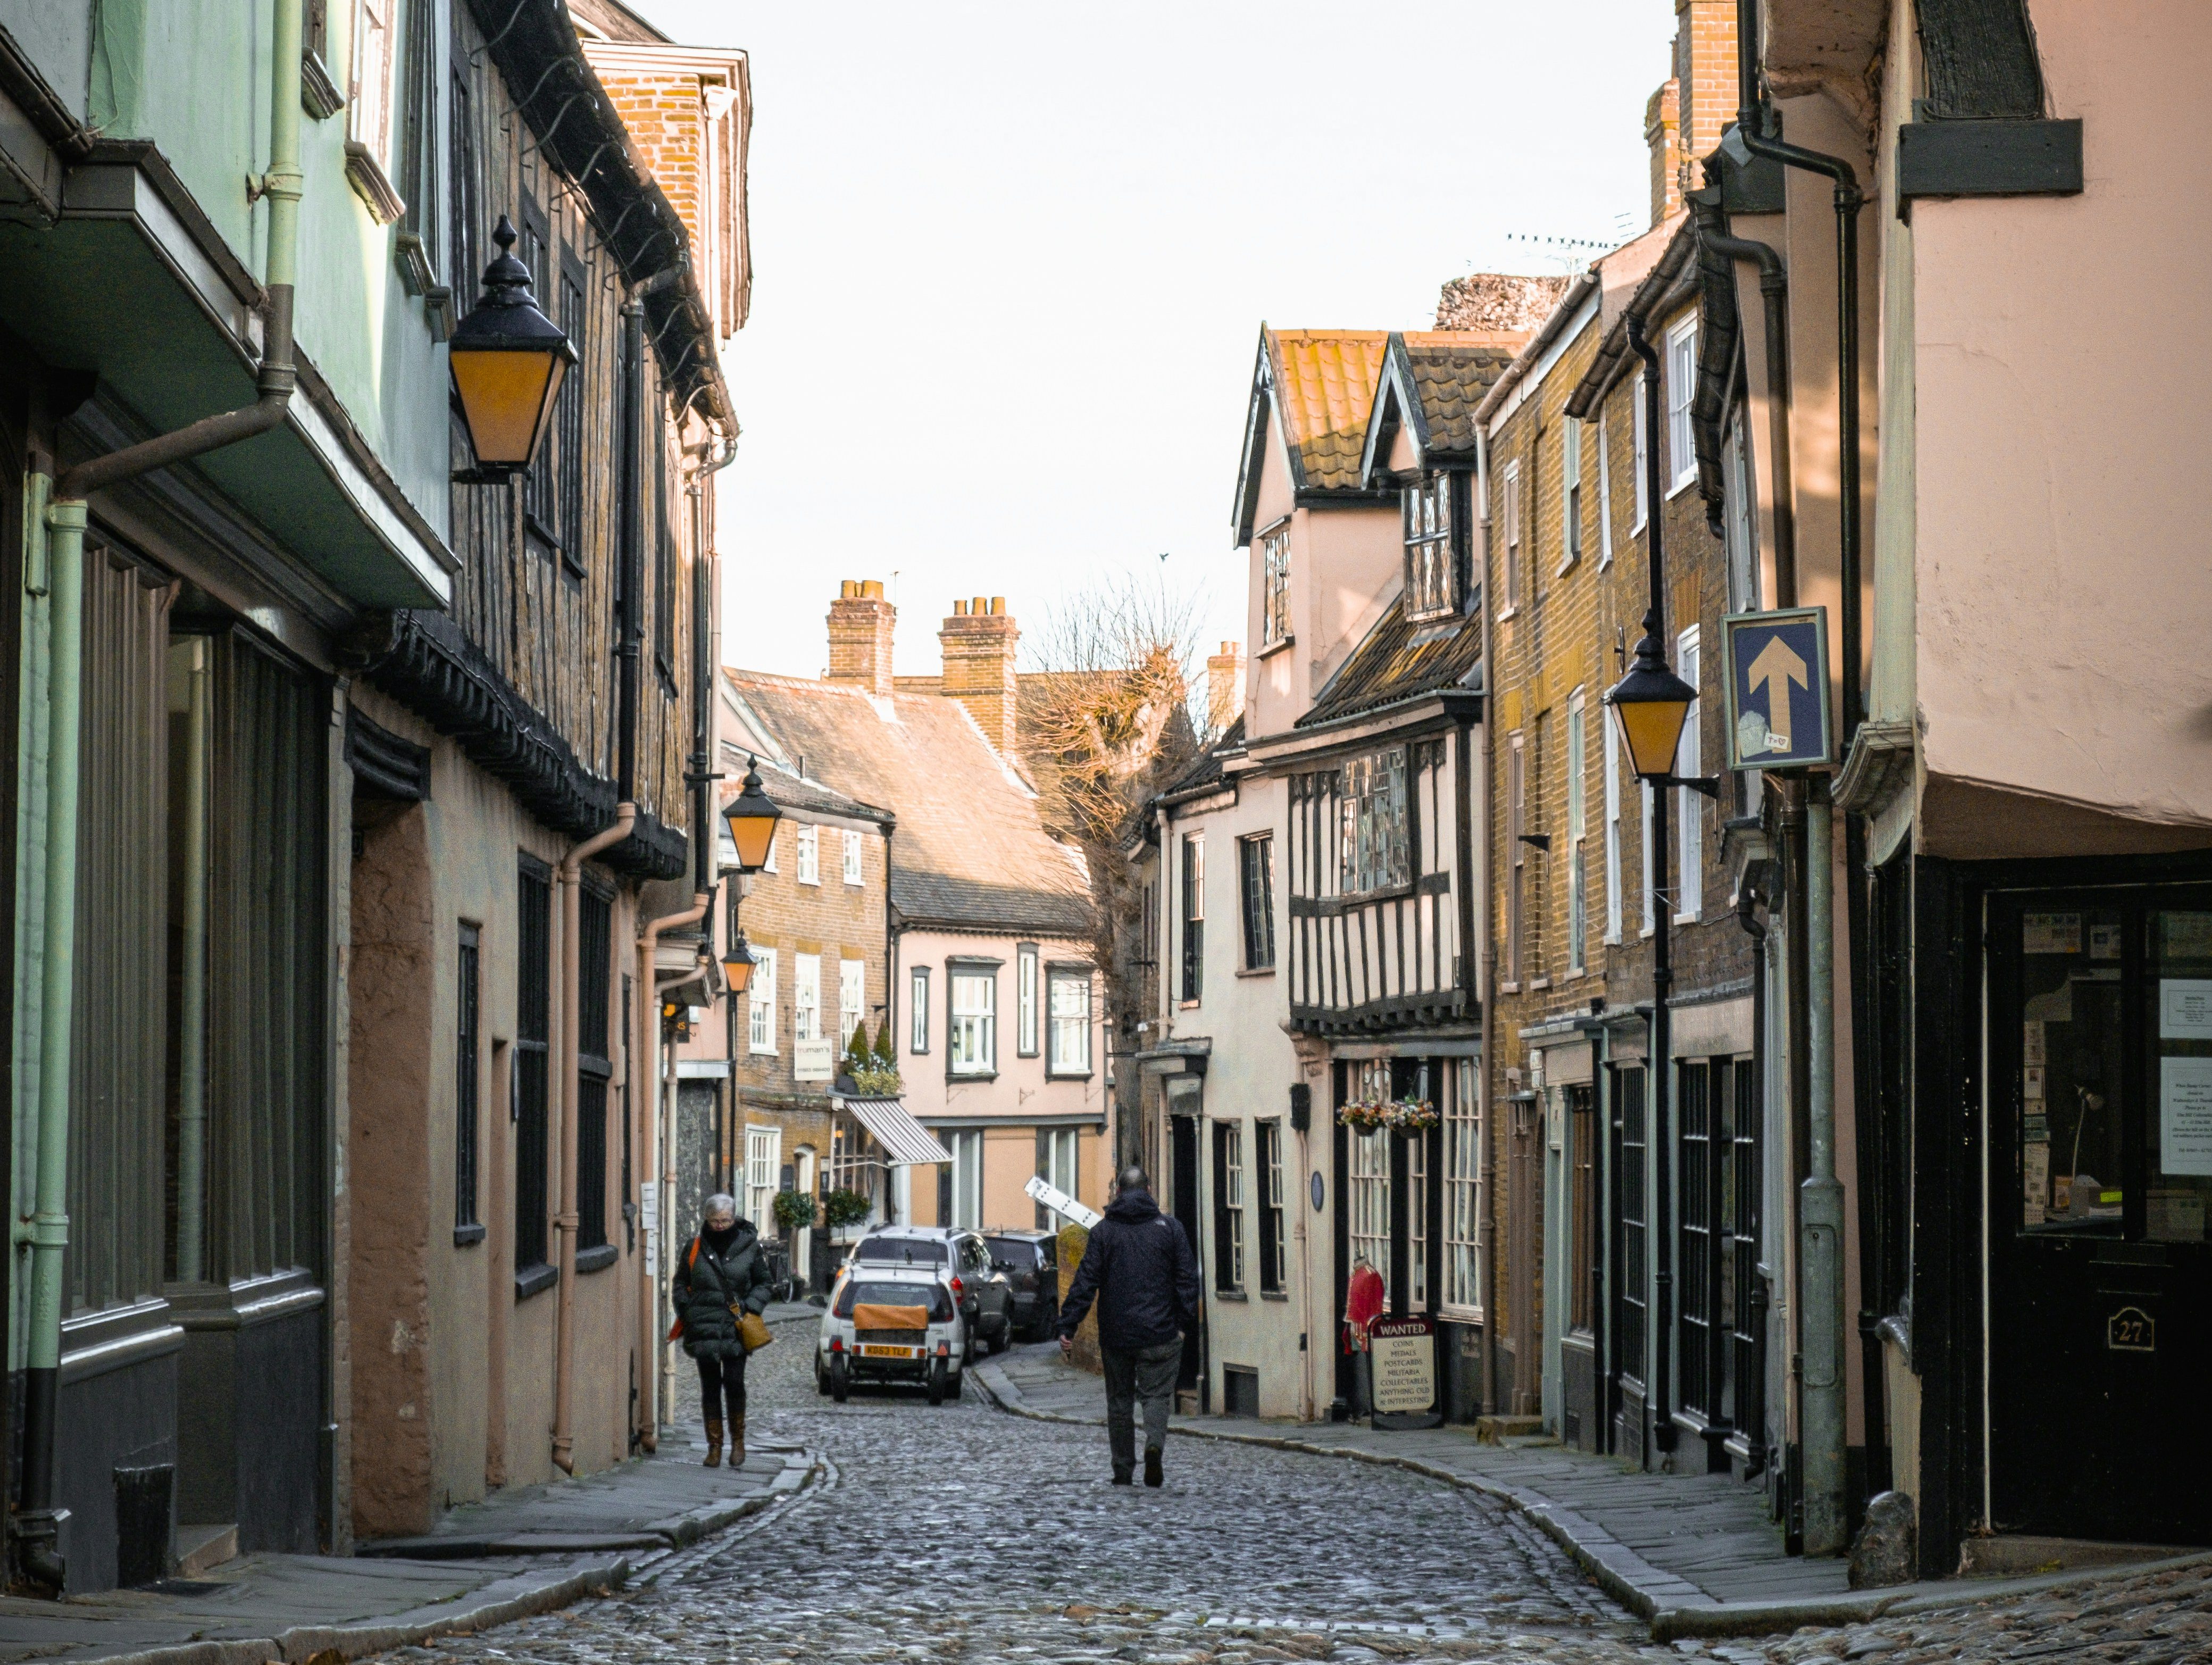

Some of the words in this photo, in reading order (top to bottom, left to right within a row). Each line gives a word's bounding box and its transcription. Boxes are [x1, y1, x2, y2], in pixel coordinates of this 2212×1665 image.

[1380, 1323, 1426, 1336] WANTED
[2119, 1320, 2143, 1342] 27
[1384, 1359, 1423, 1367] POSTCARDS
[1380, 1377, 1428, 1386] COLLECTABLES
[1388, 1396, 1429, 1405] INTERESTING
